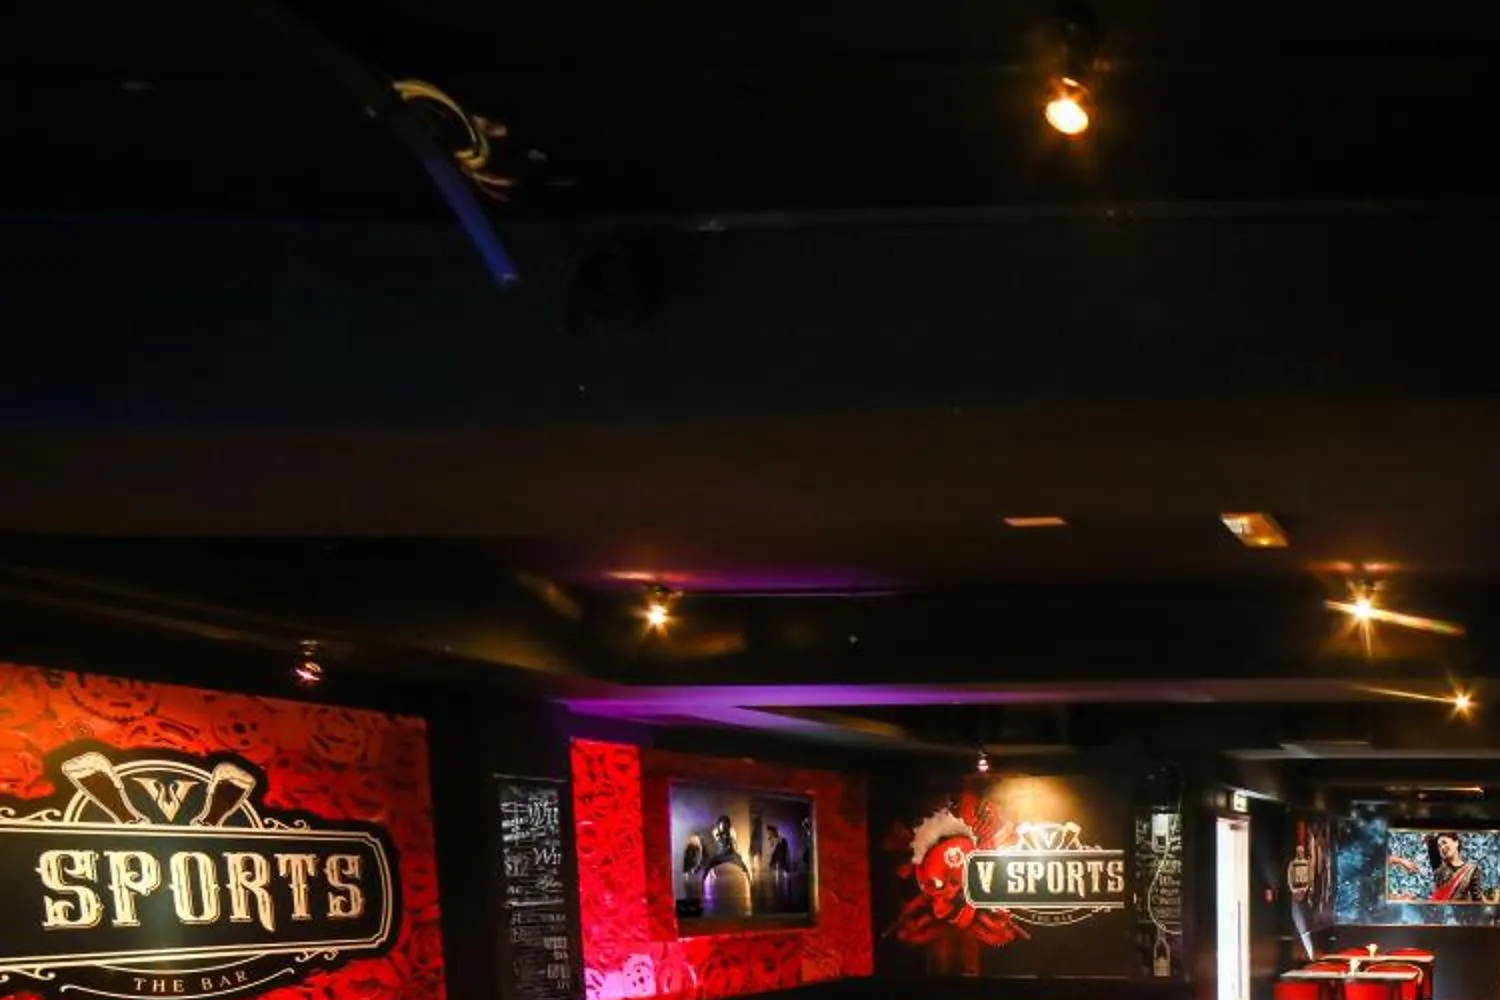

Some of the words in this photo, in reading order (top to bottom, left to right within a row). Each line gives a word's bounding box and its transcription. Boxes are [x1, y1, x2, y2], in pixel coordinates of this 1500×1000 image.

[35, 850, 366, 932] SPORTS
[976, 861, 995, 893] V
[1007, 860, 1125, 897] SPORTS
[133, 977, 184, 992] THE
[201, 970, 248, 990] BAR
